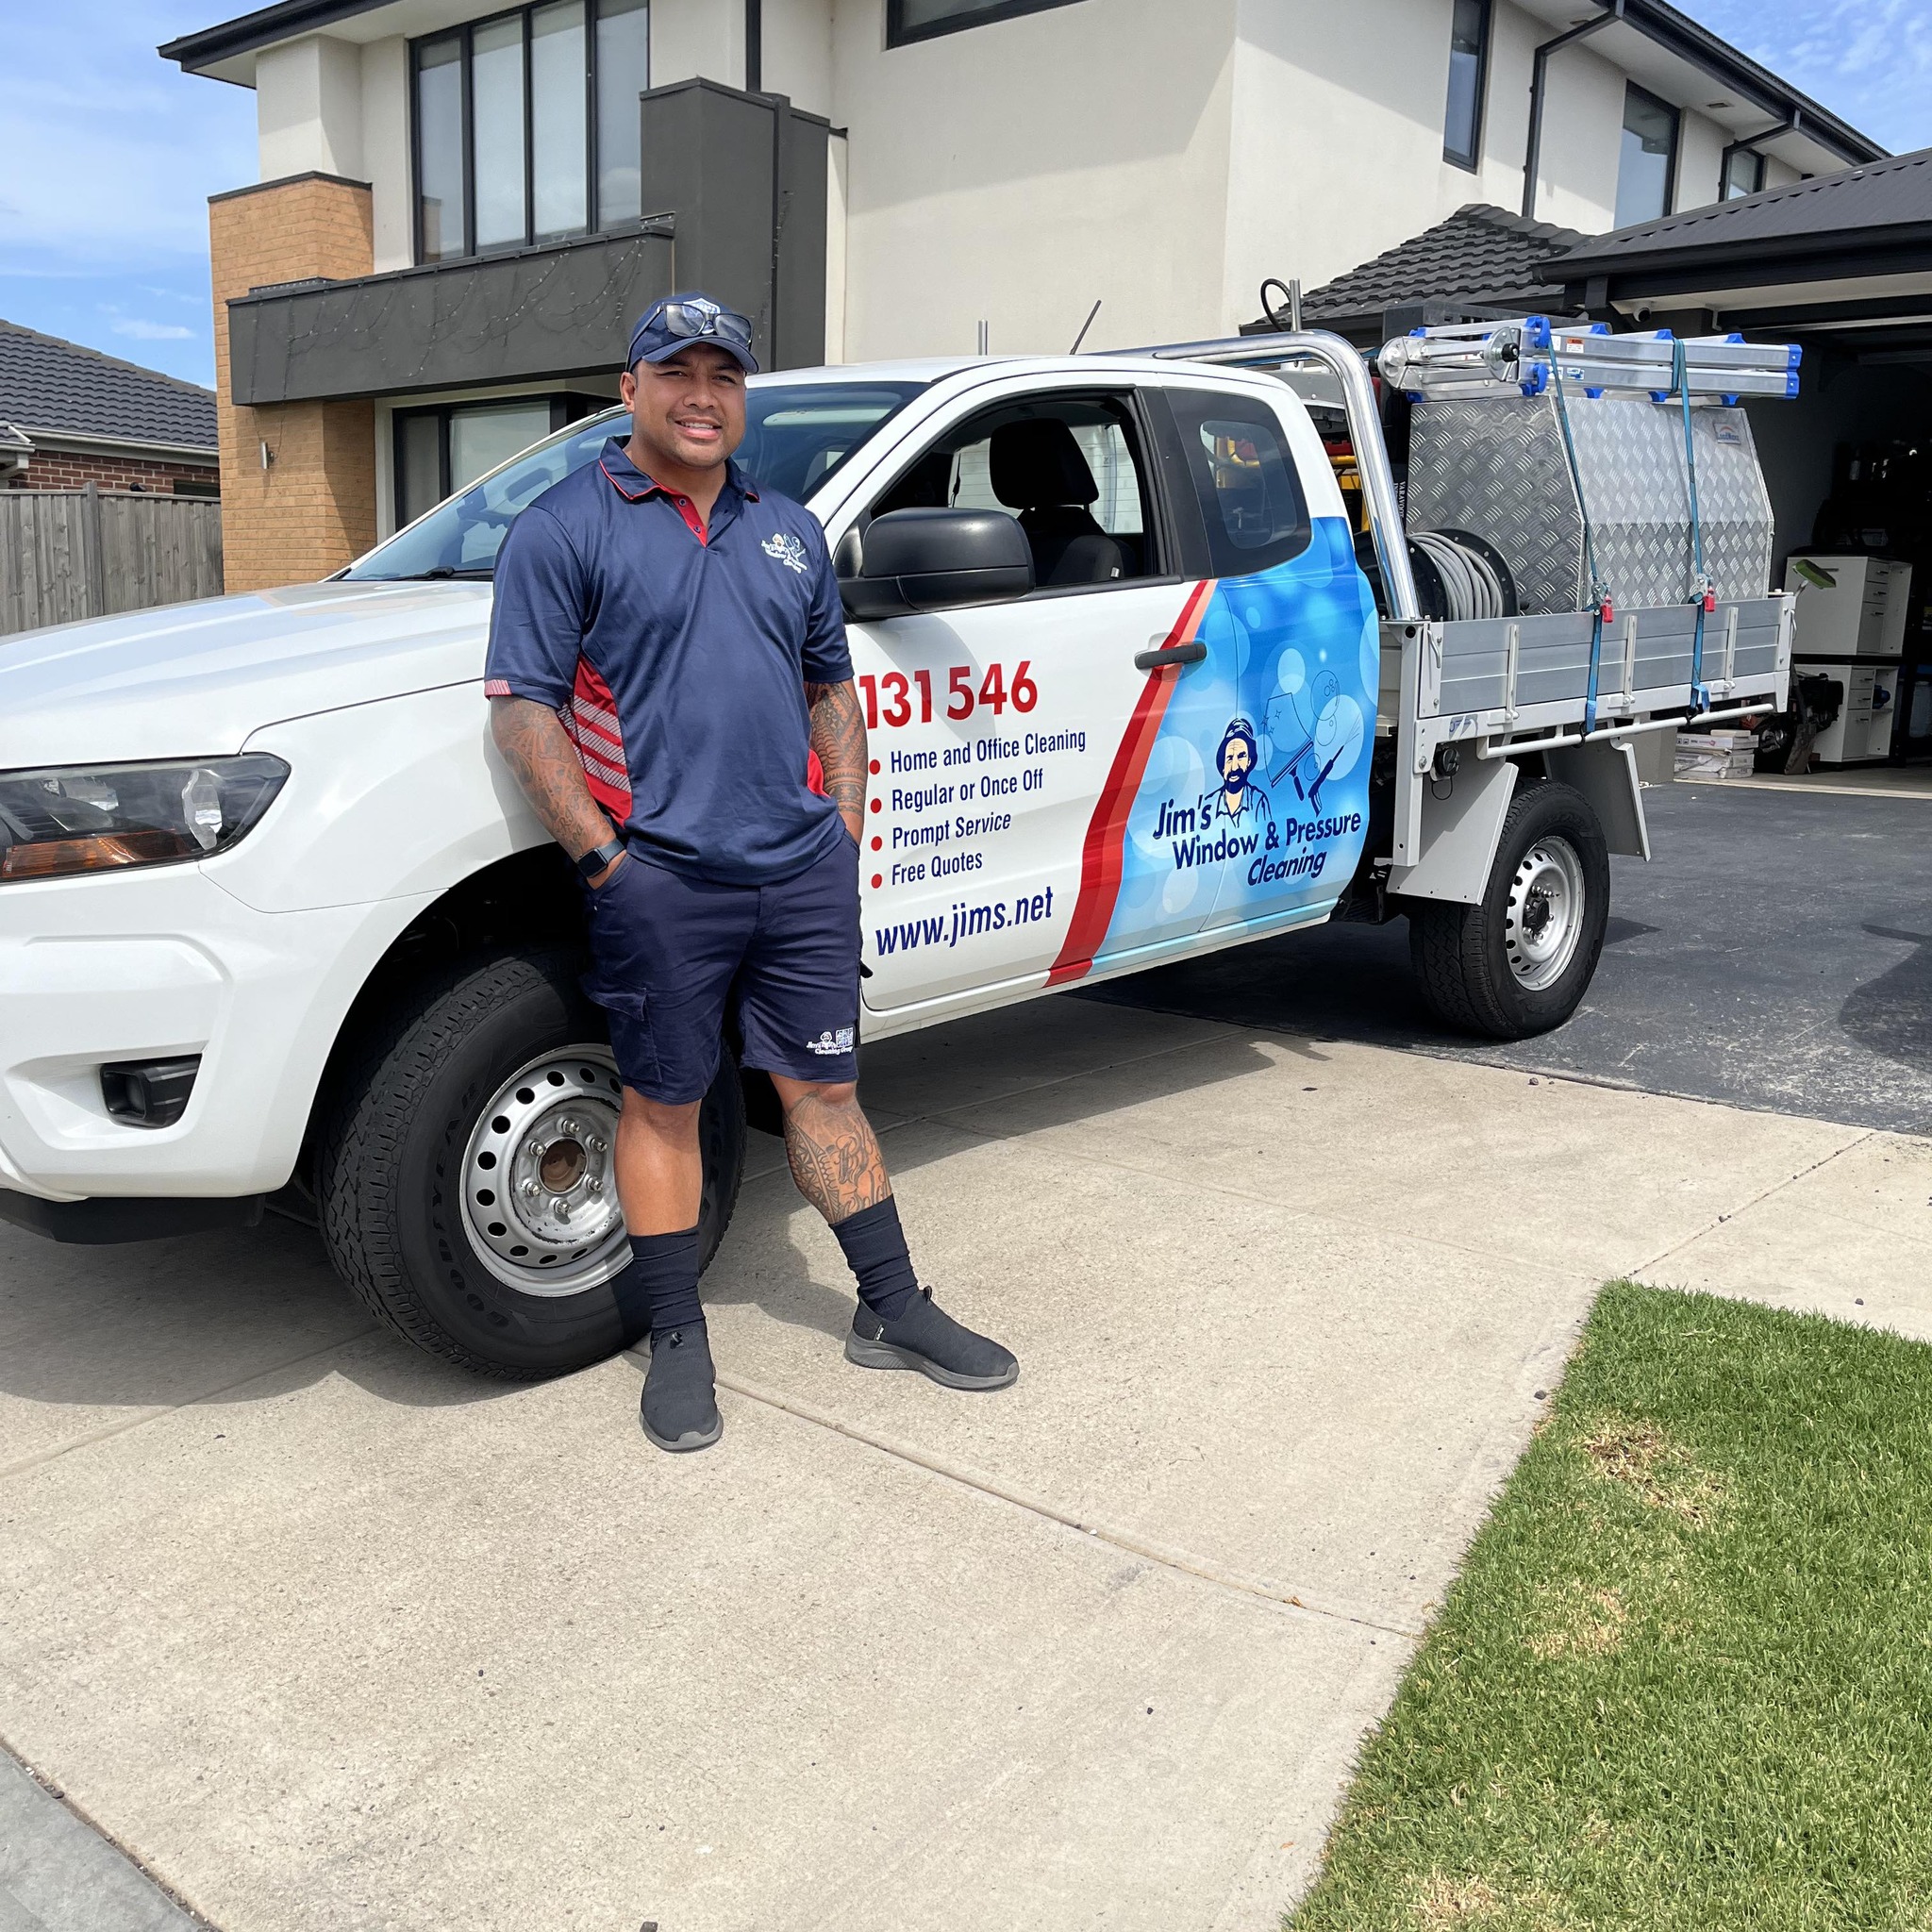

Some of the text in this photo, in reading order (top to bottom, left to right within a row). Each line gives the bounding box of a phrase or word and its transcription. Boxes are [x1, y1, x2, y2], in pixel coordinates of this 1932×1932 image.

[859, 660, 1038, 730] 131 546
[891, 729, 1086, 774] Home and Office Cleaning
[892, 768, 1043, 813] Regular or Once Off
[892, 811, 1011, 849] Prompt Service
[1153, 794, 1211, 840] Jim's
[1173, 812, 1361, 870] Window & Pressure
[891, 852, 983, 885] Free Quotes
[1247, 847, 1327, 886] Cleaning
[875, 886, 1054, 957] www.jims.net
